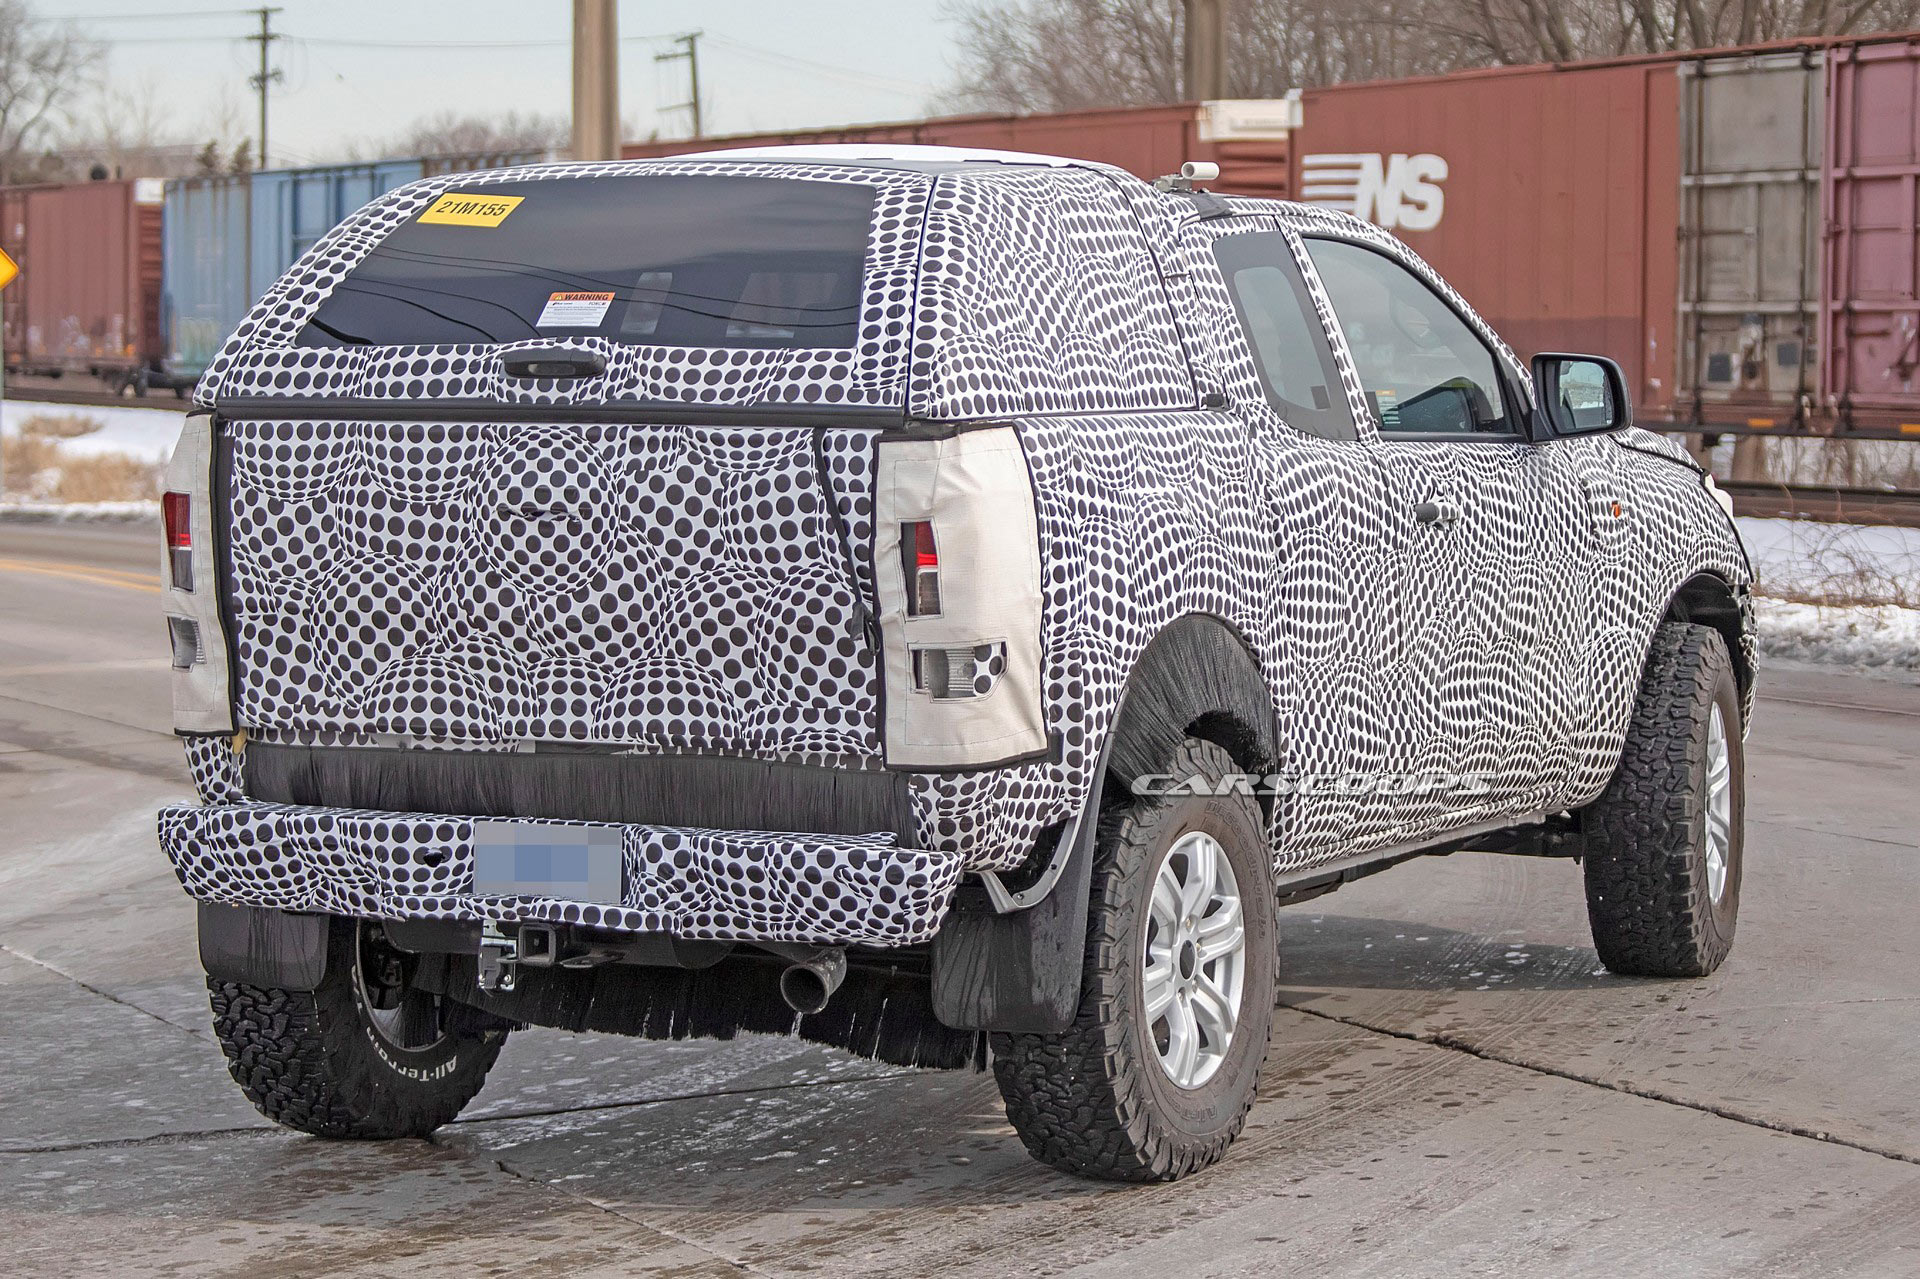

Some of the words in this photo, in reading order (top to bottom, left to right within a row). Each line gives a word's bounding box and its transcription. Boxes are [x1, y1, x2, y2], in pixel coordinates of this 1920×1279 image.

[1354, 153, 1449, 230] NS
[436, 201, 510, 217] 21M155
[564, 293, 609, 301] WARNING
